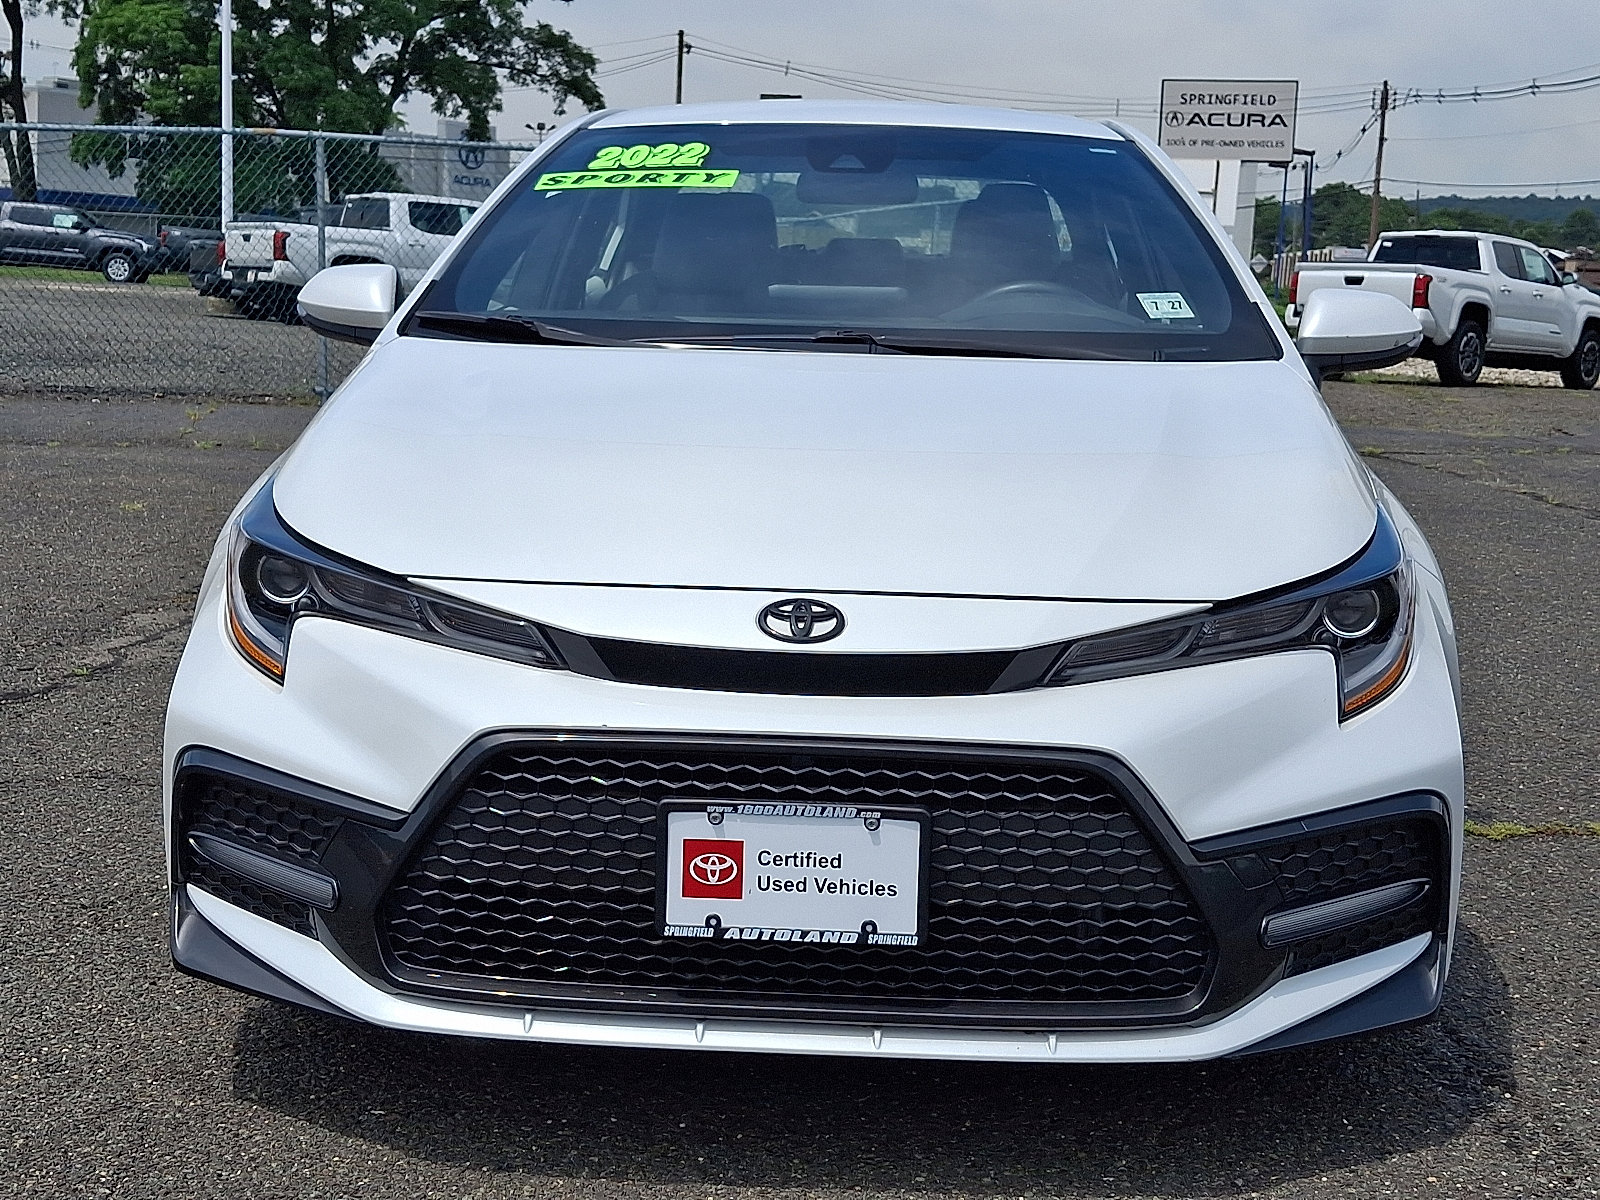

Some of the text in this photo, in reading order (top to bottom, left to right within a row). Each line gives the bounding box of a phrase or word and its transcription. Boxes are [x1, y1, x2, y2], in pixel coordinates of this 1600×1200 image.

[1180, 93, 1277, 106] SPRINGFIELD
[1185, 112, 1288, 128] ACURA
[1188, 138, 1198, 147] OF
[1200, 138, 1245, 148] PRE-OWNED
[1246, 139, 1285, 149] VEHICLES
[588, 142, 711, 169] 2022
[453, 174, 492, 187] ACURA
[541, 172, 730, 186] SPORTY
[1150, 300, 1182, 310] 7 27
[706, 804, 882, 819] www.1800AUTOLAND.com
[757, 850, 842, 869] Certified
[757, 875, 898, 897] Used Vehicles
[664, 926, 918, 946] SPRINGFIELD AUTOLAND SPRINGFIELD
